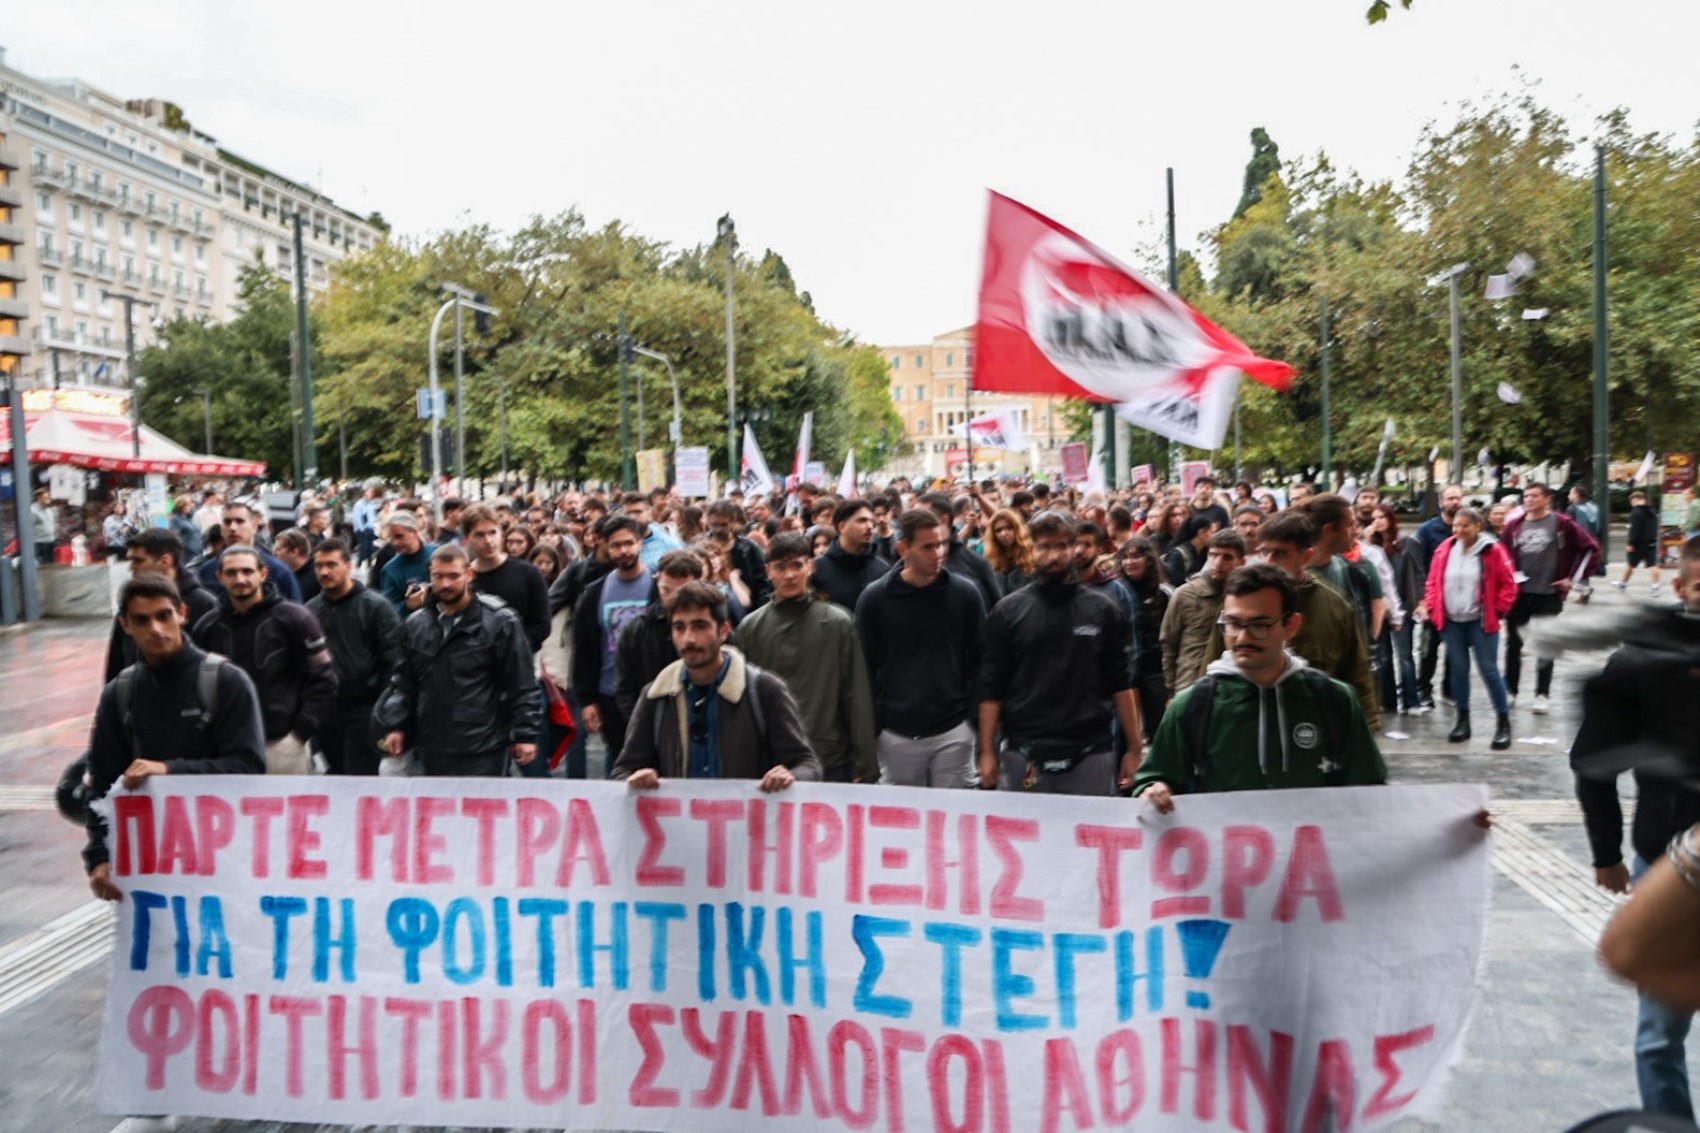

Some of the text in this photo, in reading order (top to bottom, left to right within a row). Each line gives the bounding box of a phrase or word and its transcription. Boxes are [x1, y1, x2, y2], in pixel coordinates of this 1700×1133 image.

[113, 794, 1344, 929] ΠΑΡΤΕ ΜΕΤΡΑ ΣΤΗΡΙΞΗΣ ΤΩΡΑ
[129, 890, 1233, 1032] ΓΙΑ ΤΗ ΦΟΙΤΗΤΙΚΗ ΣΤΕΓΗ!
[127, 985, 1435, 1133] ΦΟΙΤΗΤΙΚΟΙ ΣΥΛΛΟΓΟΙ ΑΘΗΝΑΣ
